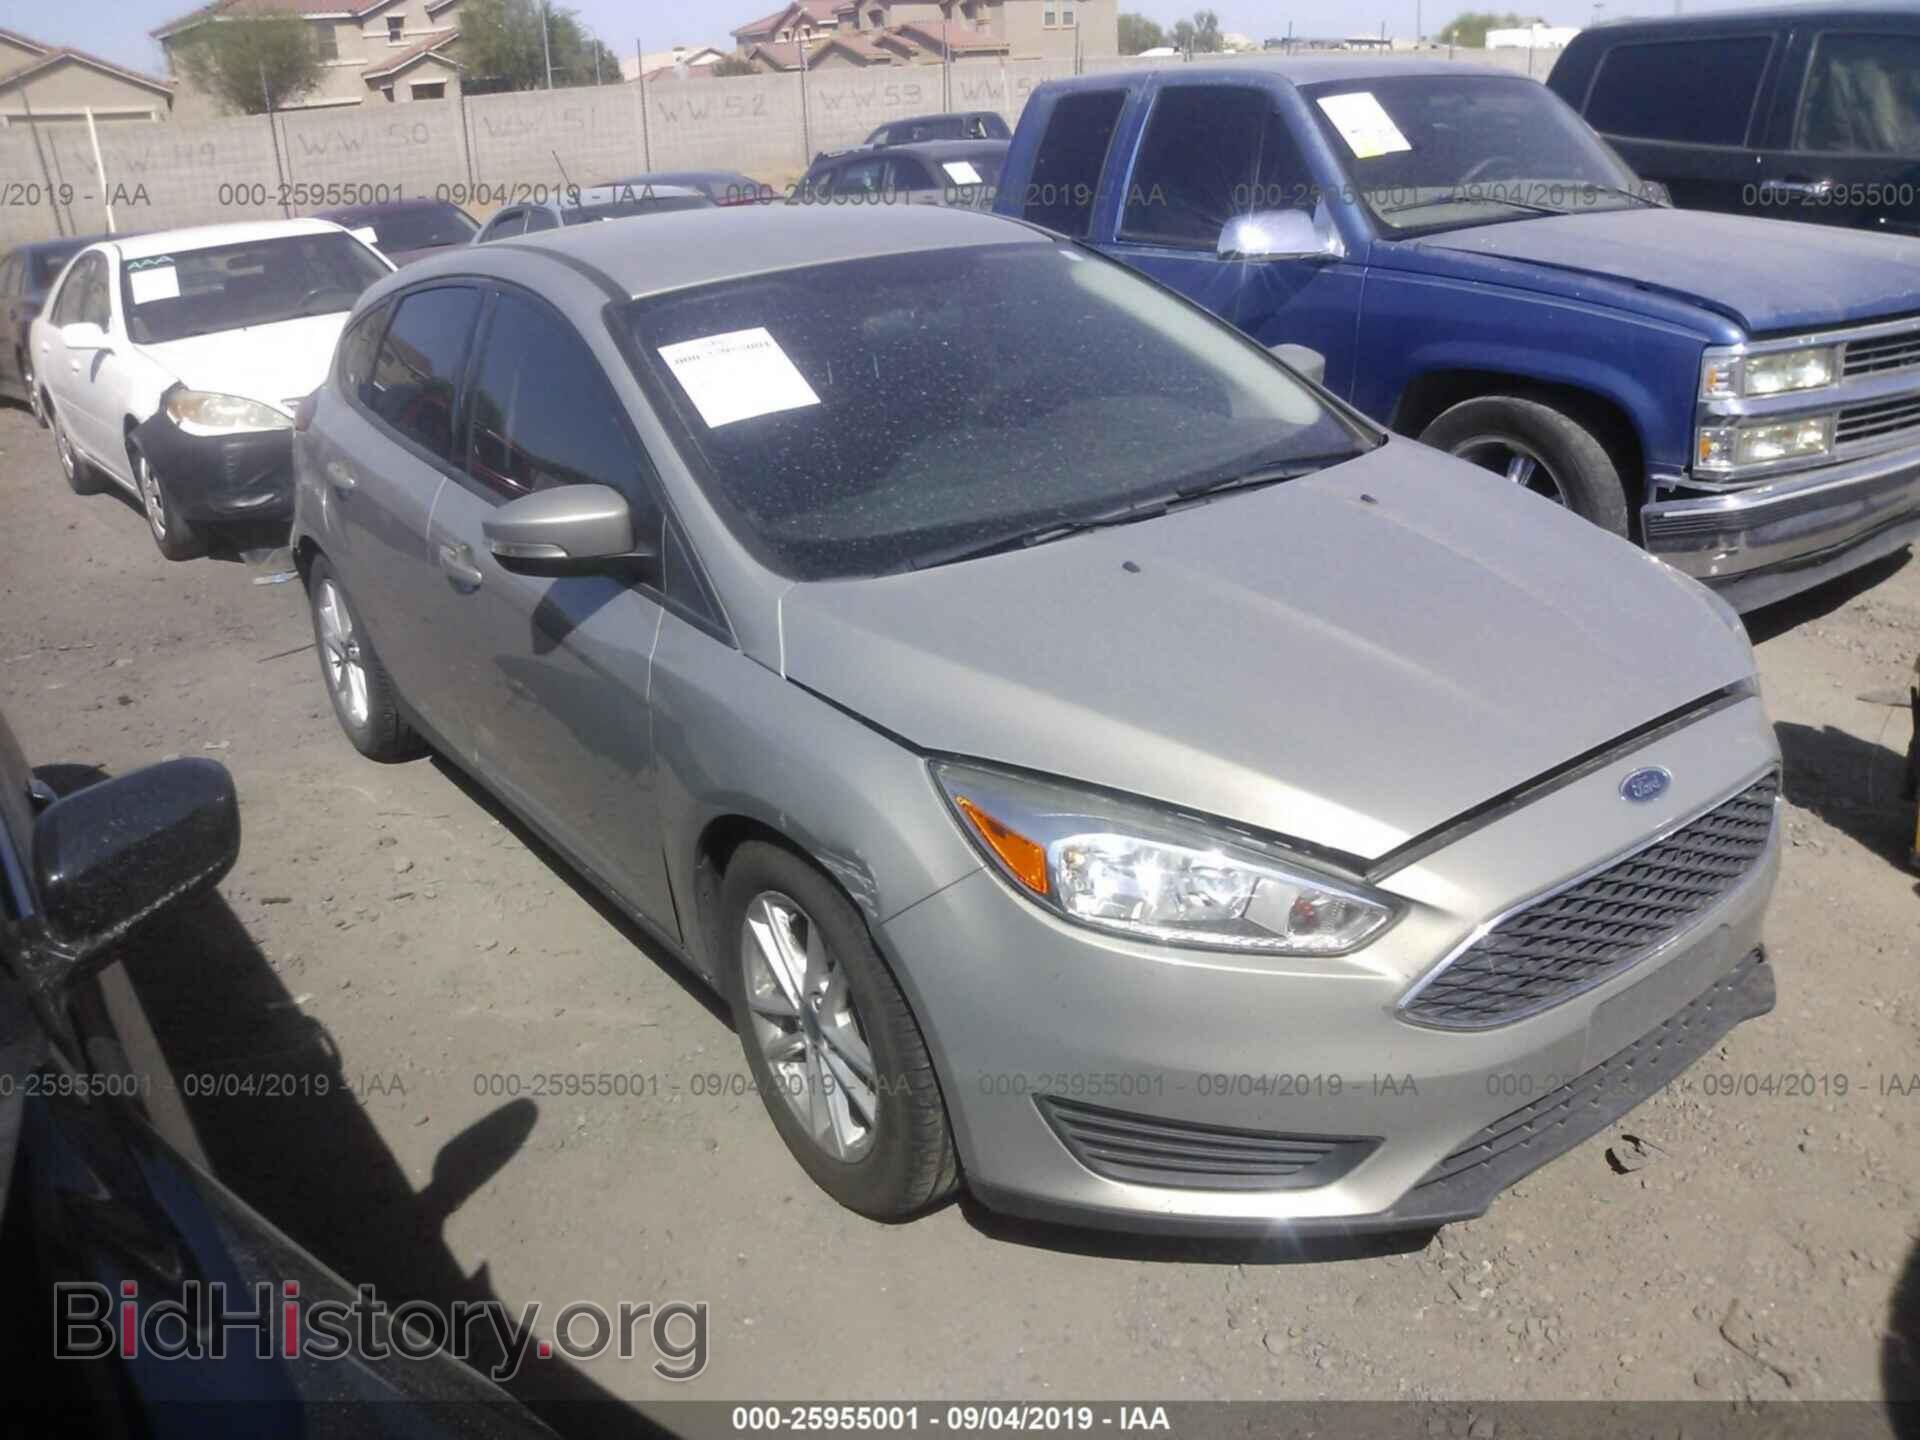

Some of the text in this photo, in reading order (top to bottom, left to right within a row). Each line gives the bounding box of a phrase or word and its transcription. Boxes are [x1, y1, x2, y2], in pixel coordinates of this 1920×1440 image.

[657, 93, 768, 122] WW 52
[819, 83, 921, 110] WW 53
[297, 121, 430, 156] WW 50
[1630, 774, 1661, 798] Ford
